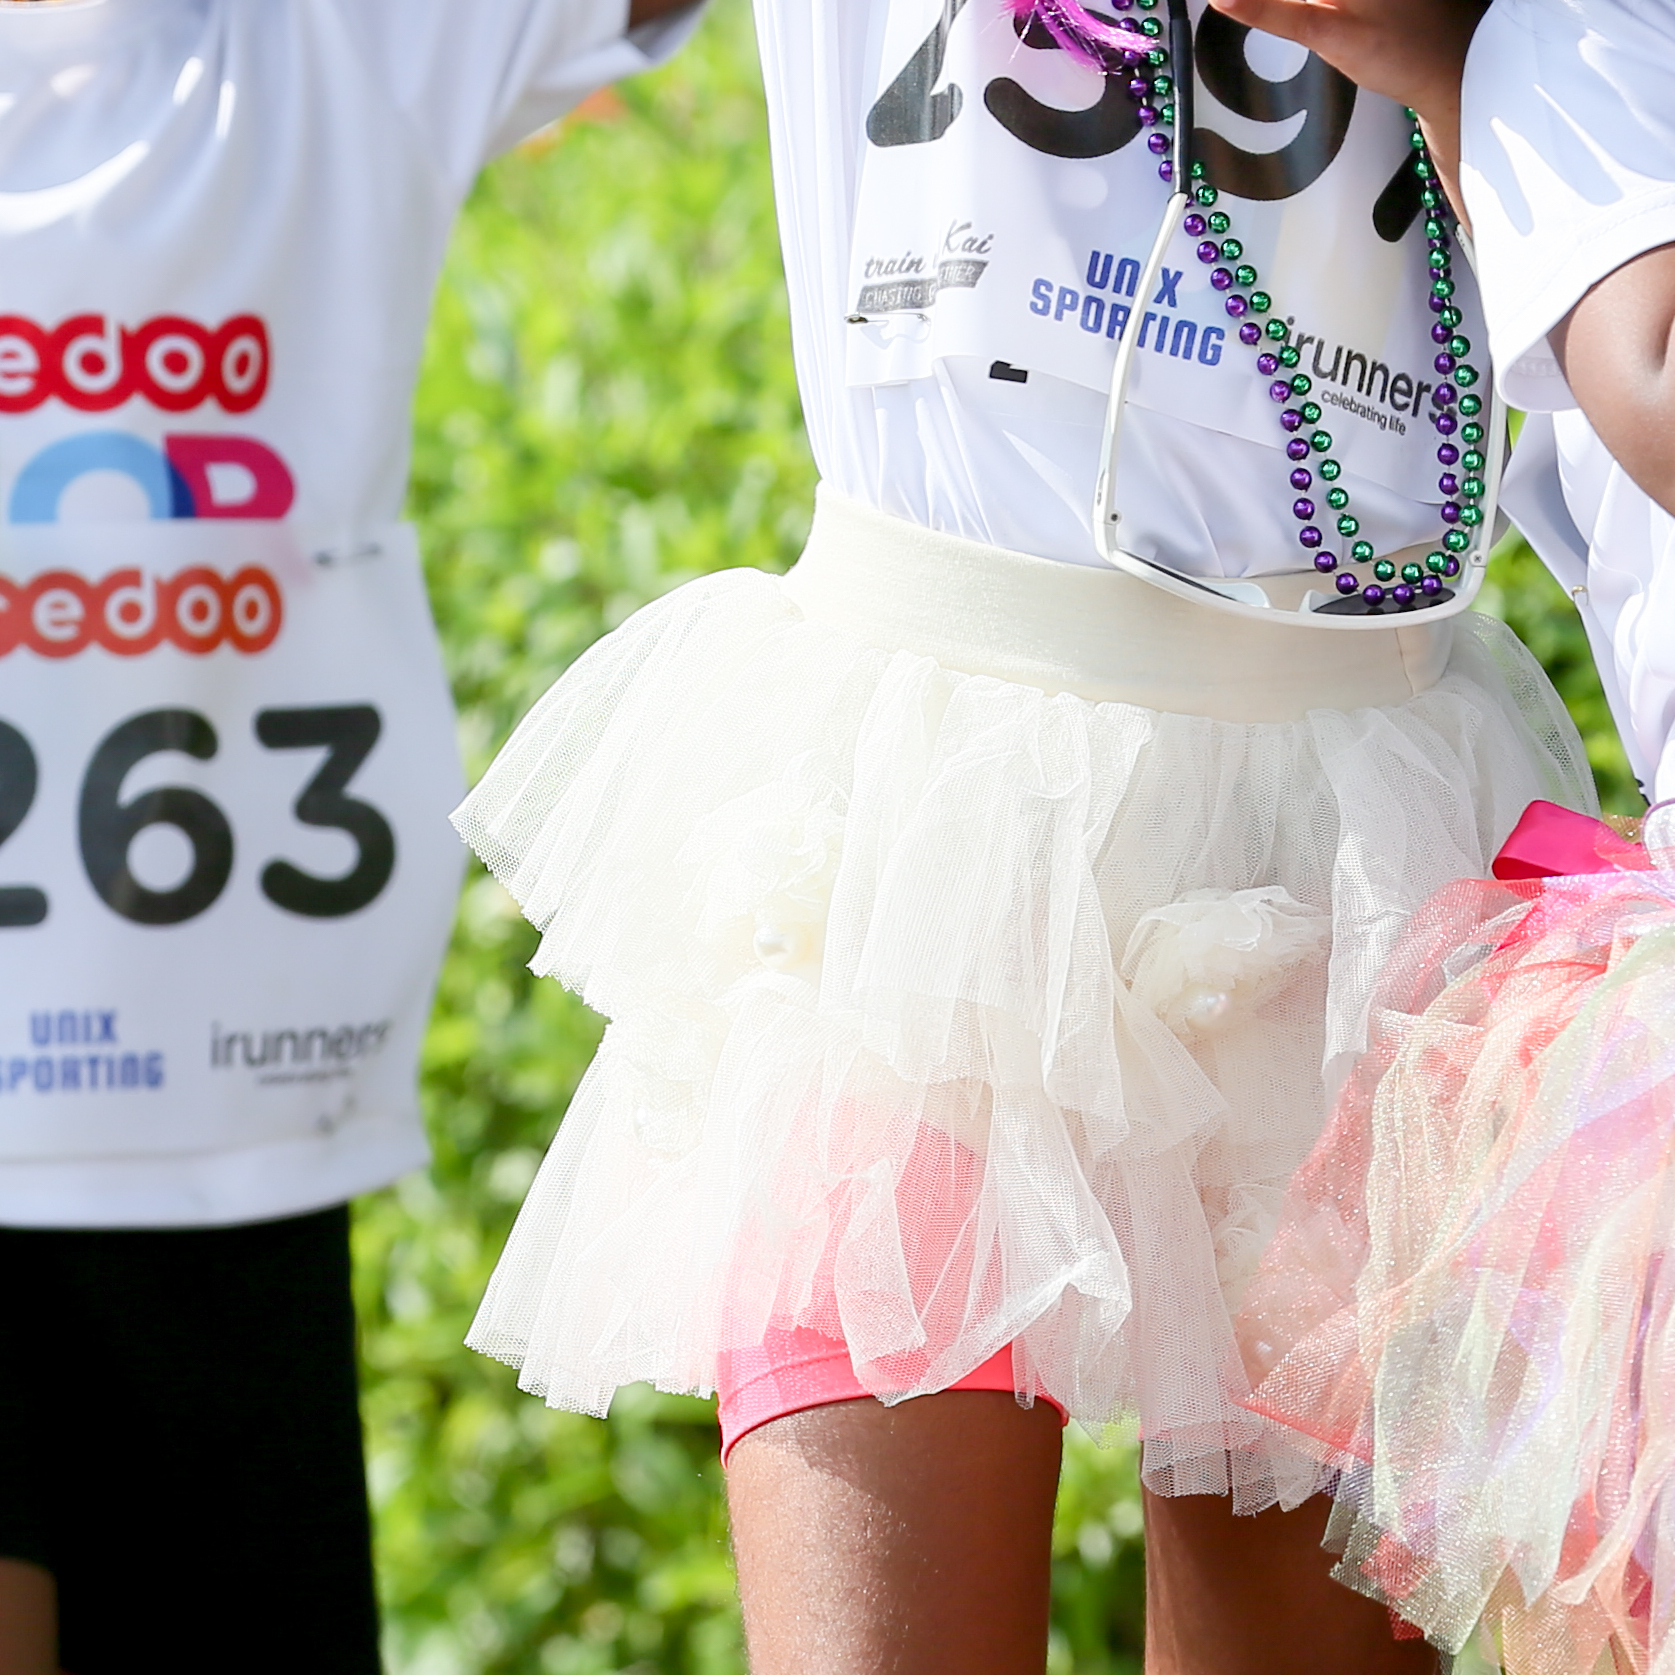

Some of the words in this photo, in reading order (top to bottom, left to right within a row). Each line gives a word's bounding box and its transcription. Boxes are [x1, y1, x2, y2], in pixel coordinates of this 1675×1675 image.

[864, 250, 925, 279] train
[943, 218, 994, 255] Kai
[1086, 250, 1183, 308] UNX
[1029, 278, 1226, 366] SPORTING
[1321, 389, 1387, 431] celebrating
[1389, 415, 1407, 436] life
[30, 1010, 117, 1046] UNIX
